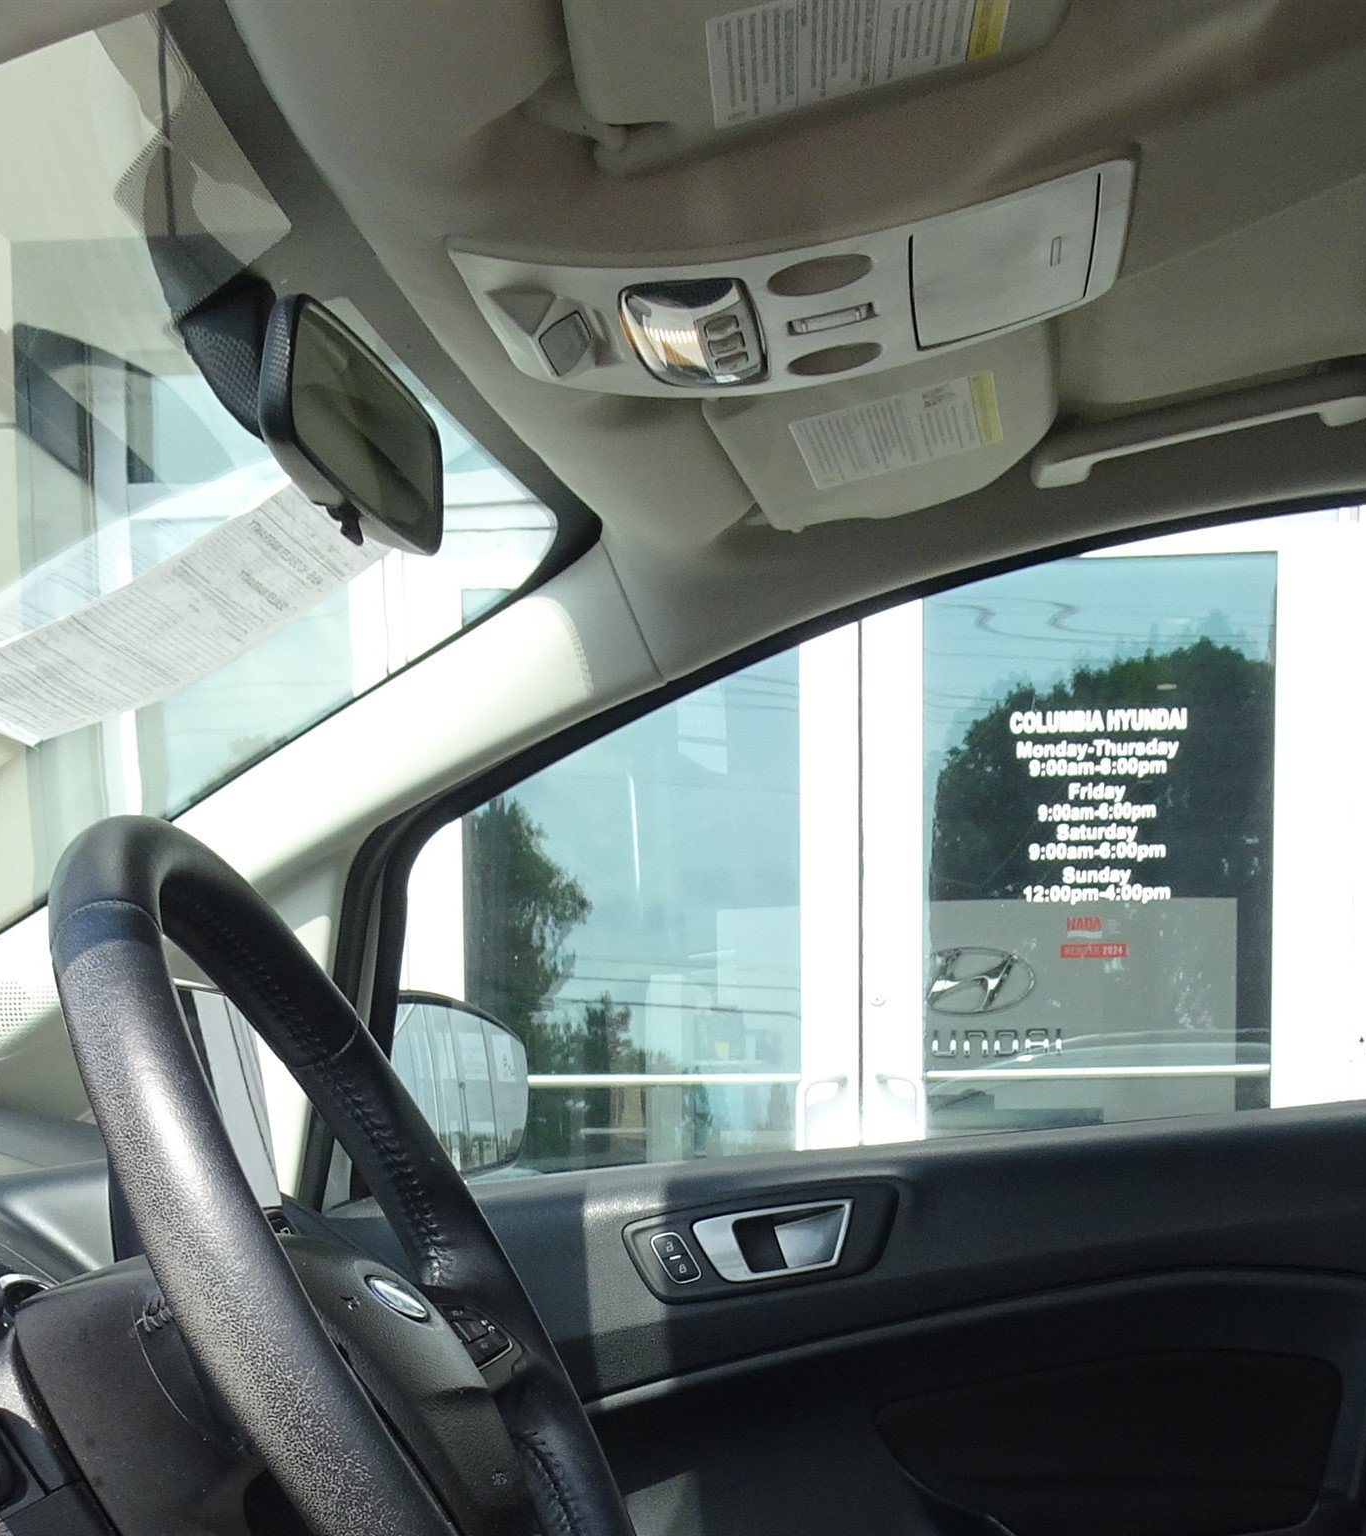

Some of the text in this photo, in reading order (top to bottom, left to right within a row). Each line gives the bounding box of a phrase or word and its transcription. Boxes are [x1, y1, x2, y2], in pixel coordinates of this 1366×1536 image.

[1009, 707, 1188, 734] COLUMBIA HYUNDAI
[1015, 737, 1180, 761] Monday-Thursday
[1068, 782, 1127, 803] Friday
[1056, 823, 1139, 843] Saturday
[1062, 866, 1132, 886] Sunday
[1022, 884, 1172, 905] 12:00pm-4:00pm
[1067, 917, 1102, 931] NADA
[1102, 945, 1124, 955] 2024
